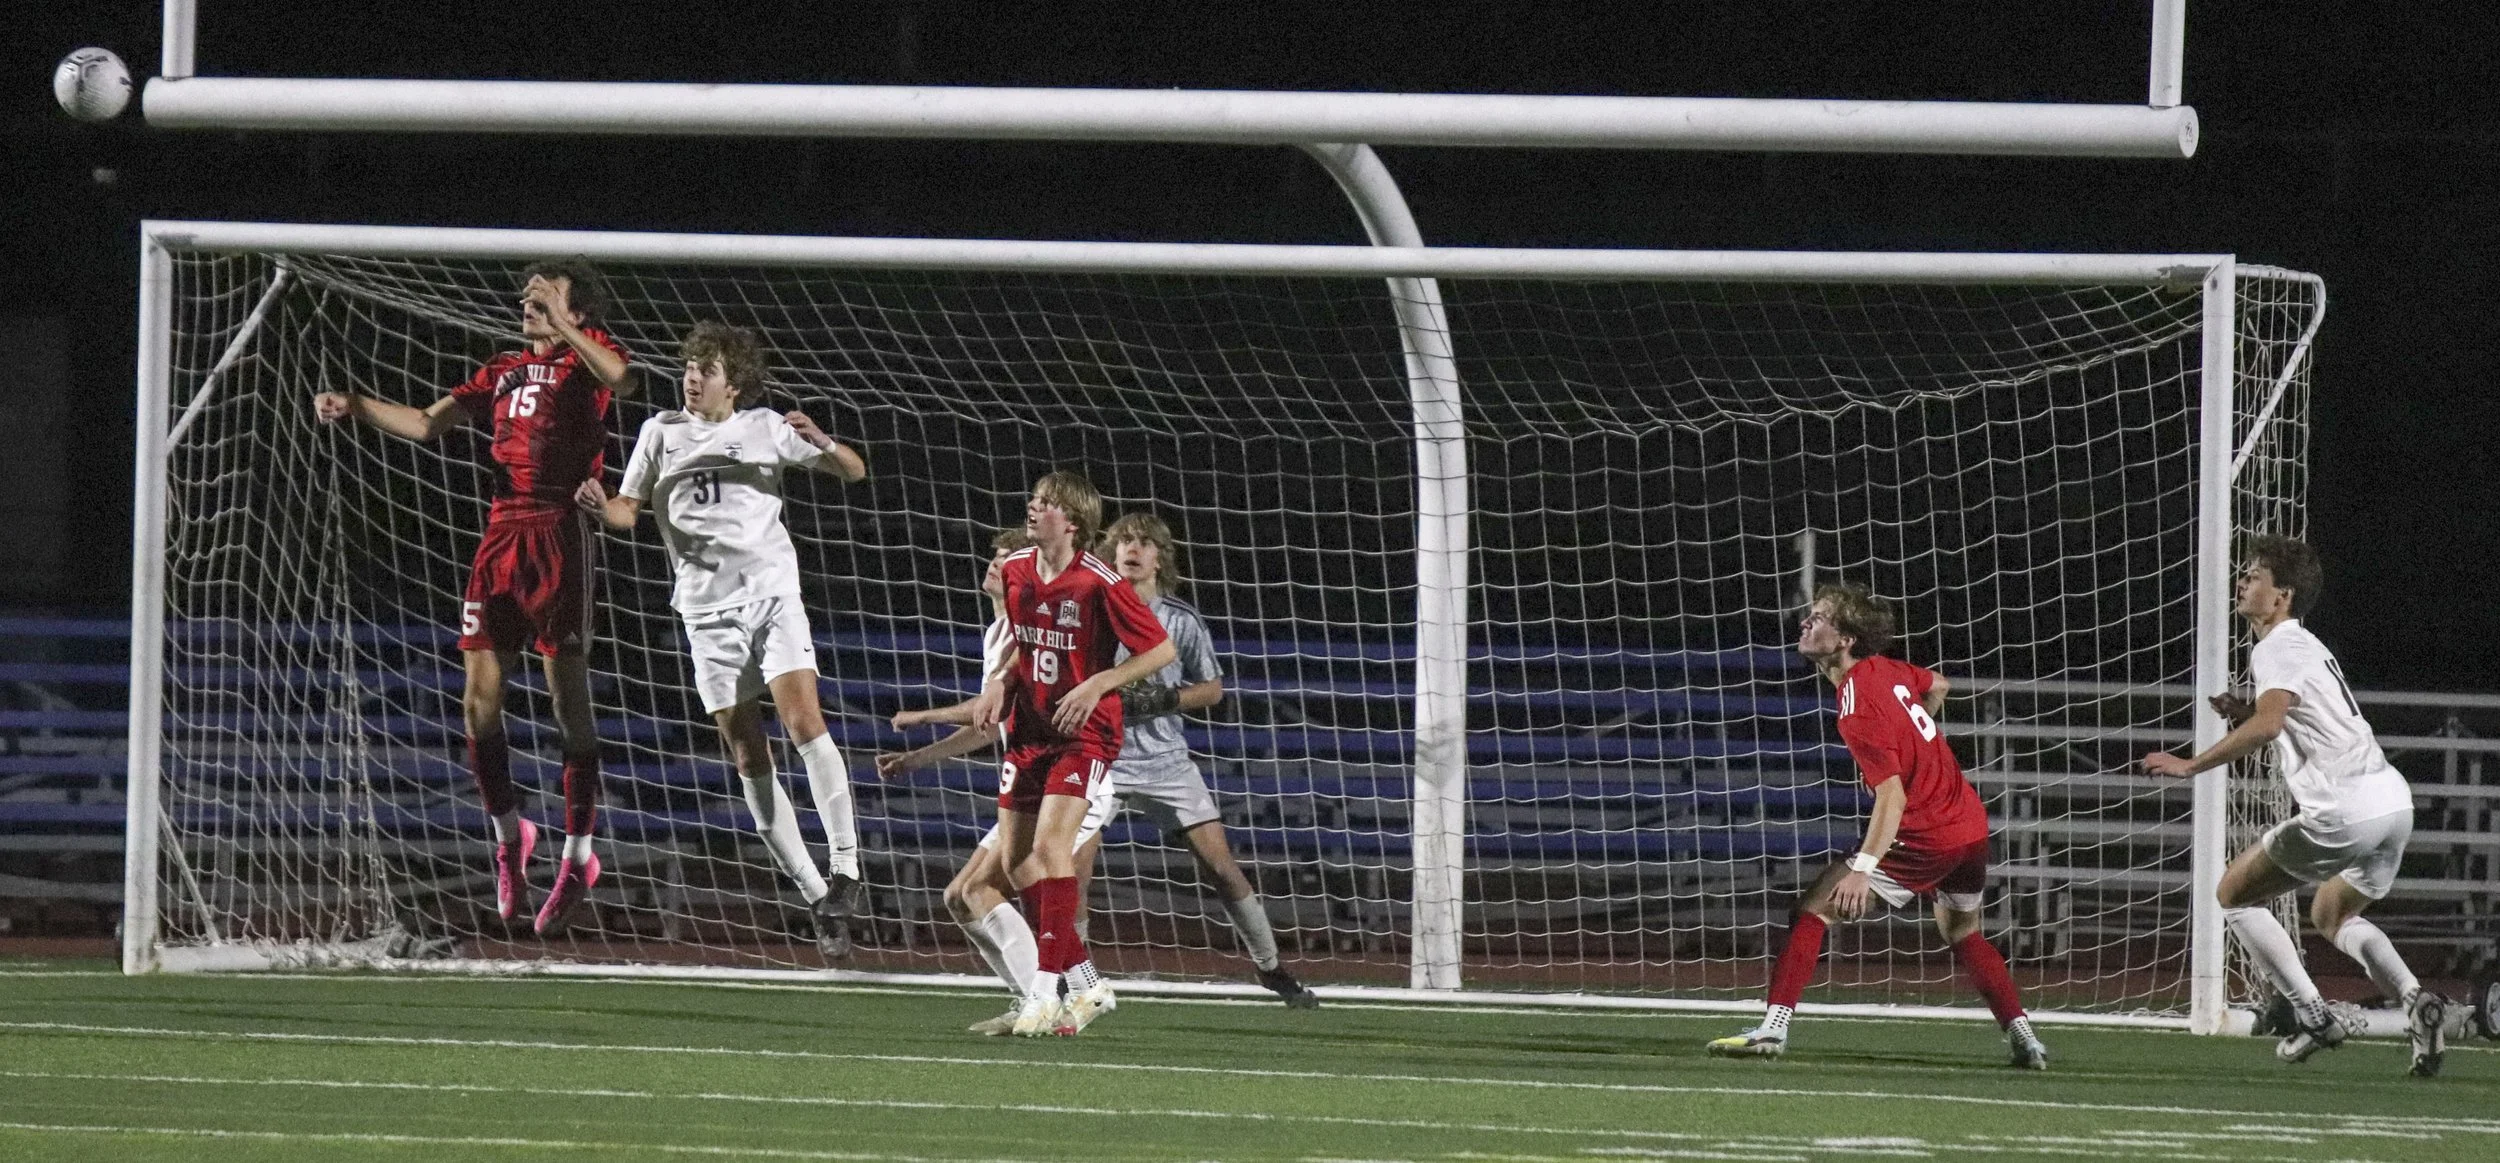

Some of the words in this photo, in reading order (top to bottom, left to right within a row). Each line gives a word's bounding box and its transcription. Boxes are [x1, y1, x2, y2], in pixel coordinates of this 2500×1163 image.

[508, 384, 541, 419] 15
[693, 470, 721, 504] 31
[1014, 623, 1045, 646] PARK
[1046, 629, 1077, 650] HILL
[1032, 648, 1059, 685] 19
[1893, 684, 1937, 743] 6
